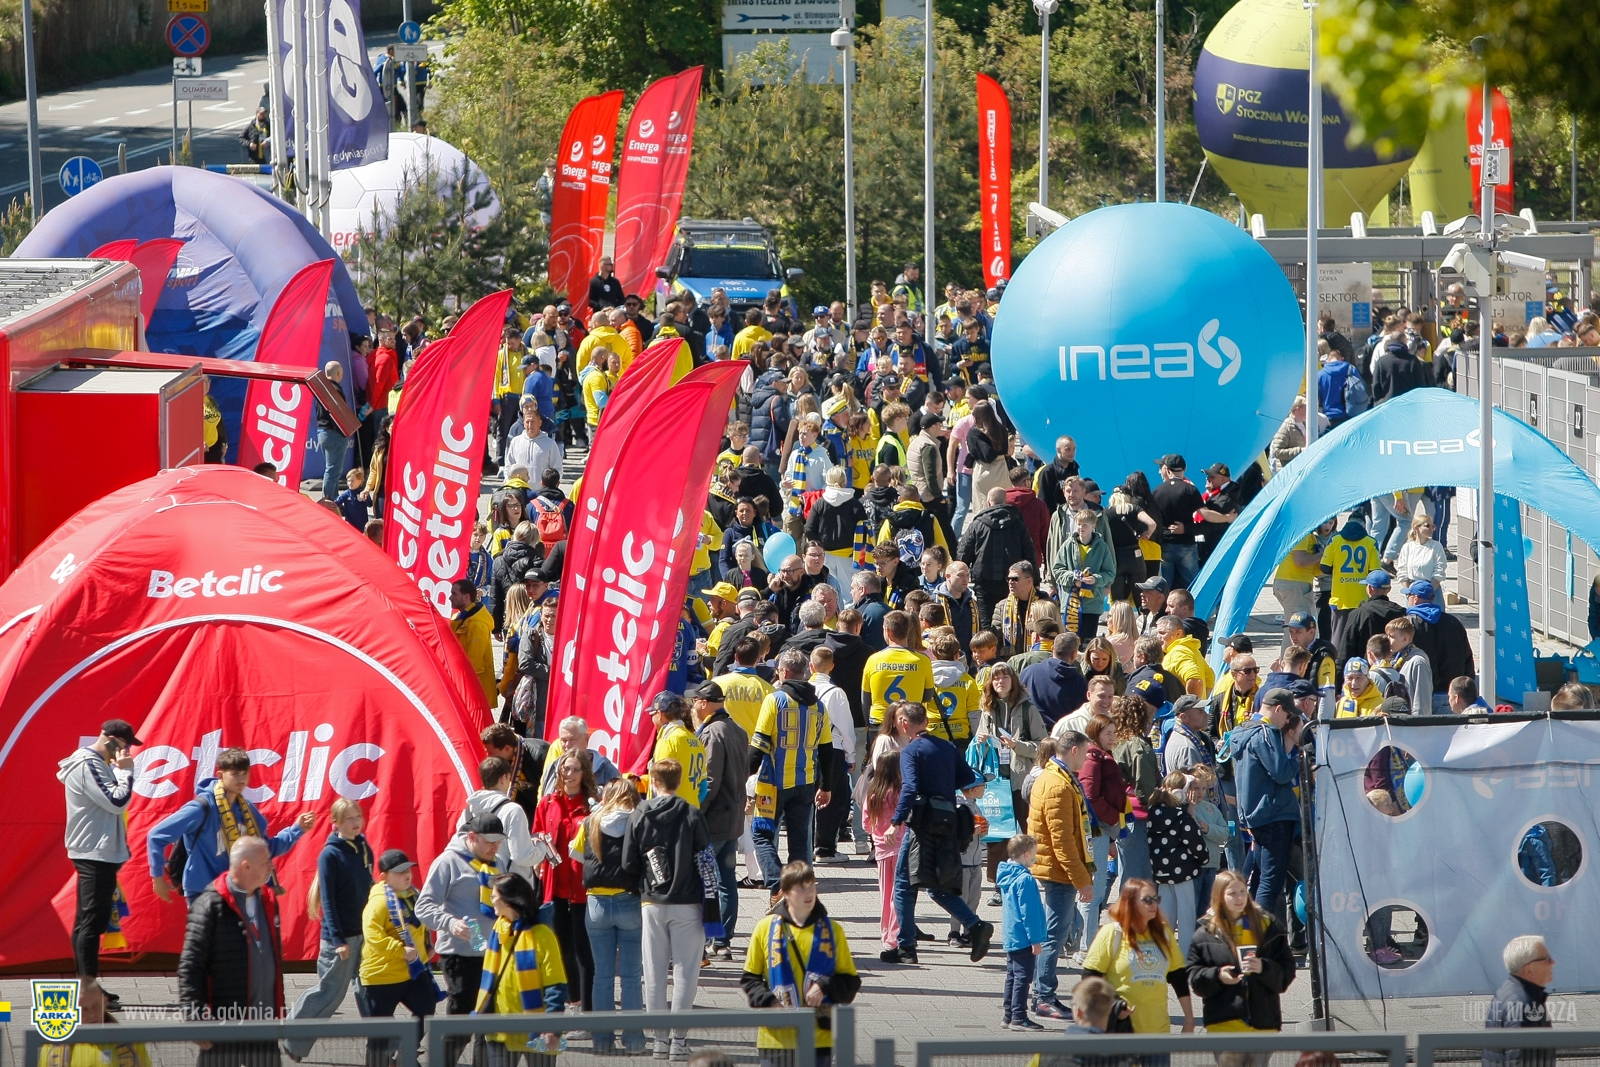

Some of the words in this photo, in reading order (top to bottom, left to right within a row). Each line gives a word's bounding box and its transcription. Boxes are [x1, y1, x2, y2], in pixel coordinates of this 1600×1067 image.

[182, 86, 224, 94] OLIMPIJSKA
[1238, 88, 1263, 105] PGZ
[1285, 109, 1342, 125] WONNA
[629, 139, 660, 155] Energa
[1282, 139, 1309, 148] MIECZN
[1318, 292, 1359, 303] SEKTOR
[1059, 342, 1195, 382] inea
[1379, 438, 1465, 456] inea
[1340, 544, 1367, 574] 29
[147, 564, 285, 599] Betclic
[588, 530, 655, 768] Betclic
[875, 662, 919, 673] LIPKOWSKI
[724, 684, 763, 703] ARKA
[884, 675, 907, 705] 6
[781, 707, 825, 750] 90
[79, 721, 386, 804] etclic
